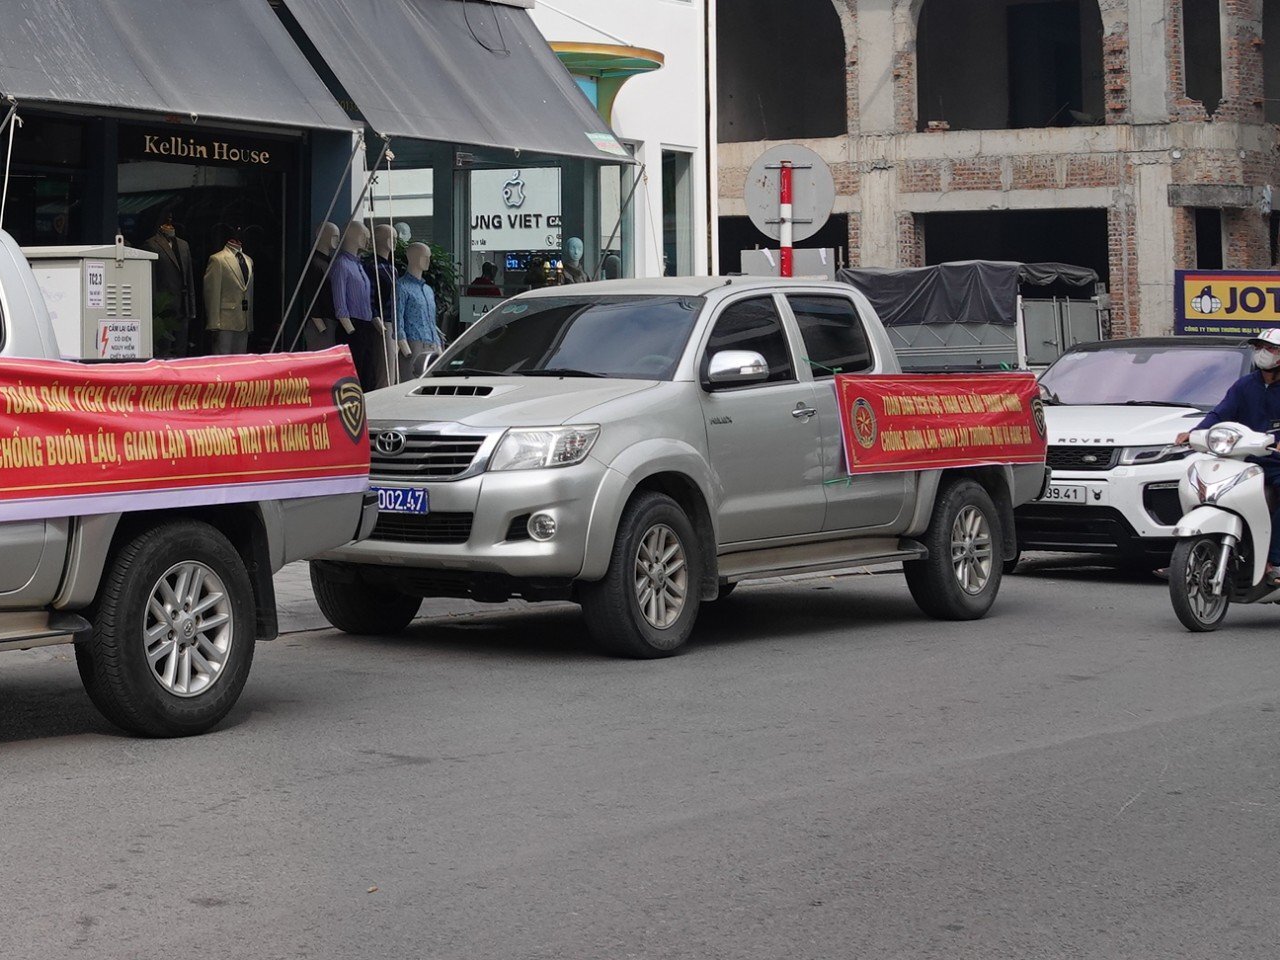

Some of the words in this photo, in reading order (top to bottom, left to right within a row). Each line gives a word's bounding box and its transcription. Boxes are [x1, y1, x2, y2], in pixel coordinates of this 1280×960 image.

[143, 134, 208, 159] Kelbin
[508, 214, 542, 229] VIET
[1224, 286, 1280, 314] JOT
[0, 380, 43, 414] TOÀN
[40, 380, 75, 412] DÂN
[73, 380, 107, 413] TÍCH
[107, 383, 137, 418] CỰC
[138, 384, 179, 413] THAM
[178, 383, 203, 411] GIA
[231, 380, 271, 407] TRANH
[46, 428, 87, 466] BUÔN
[89, 427, 121, 470] LẬU,
[123, 431, 158, 461] GIAN
[160, 424, 186, 465] LẬN
[186, 425, 238, 457] THƯƠNG
[237, 425, 263, 460] MẠI
[263, 420, 279, 453] VÀ
[280, 419, 309, 452] HÀNG
[311, 413, 331, 451] GIẢ
[378, 490, 424, 511] 002.47
